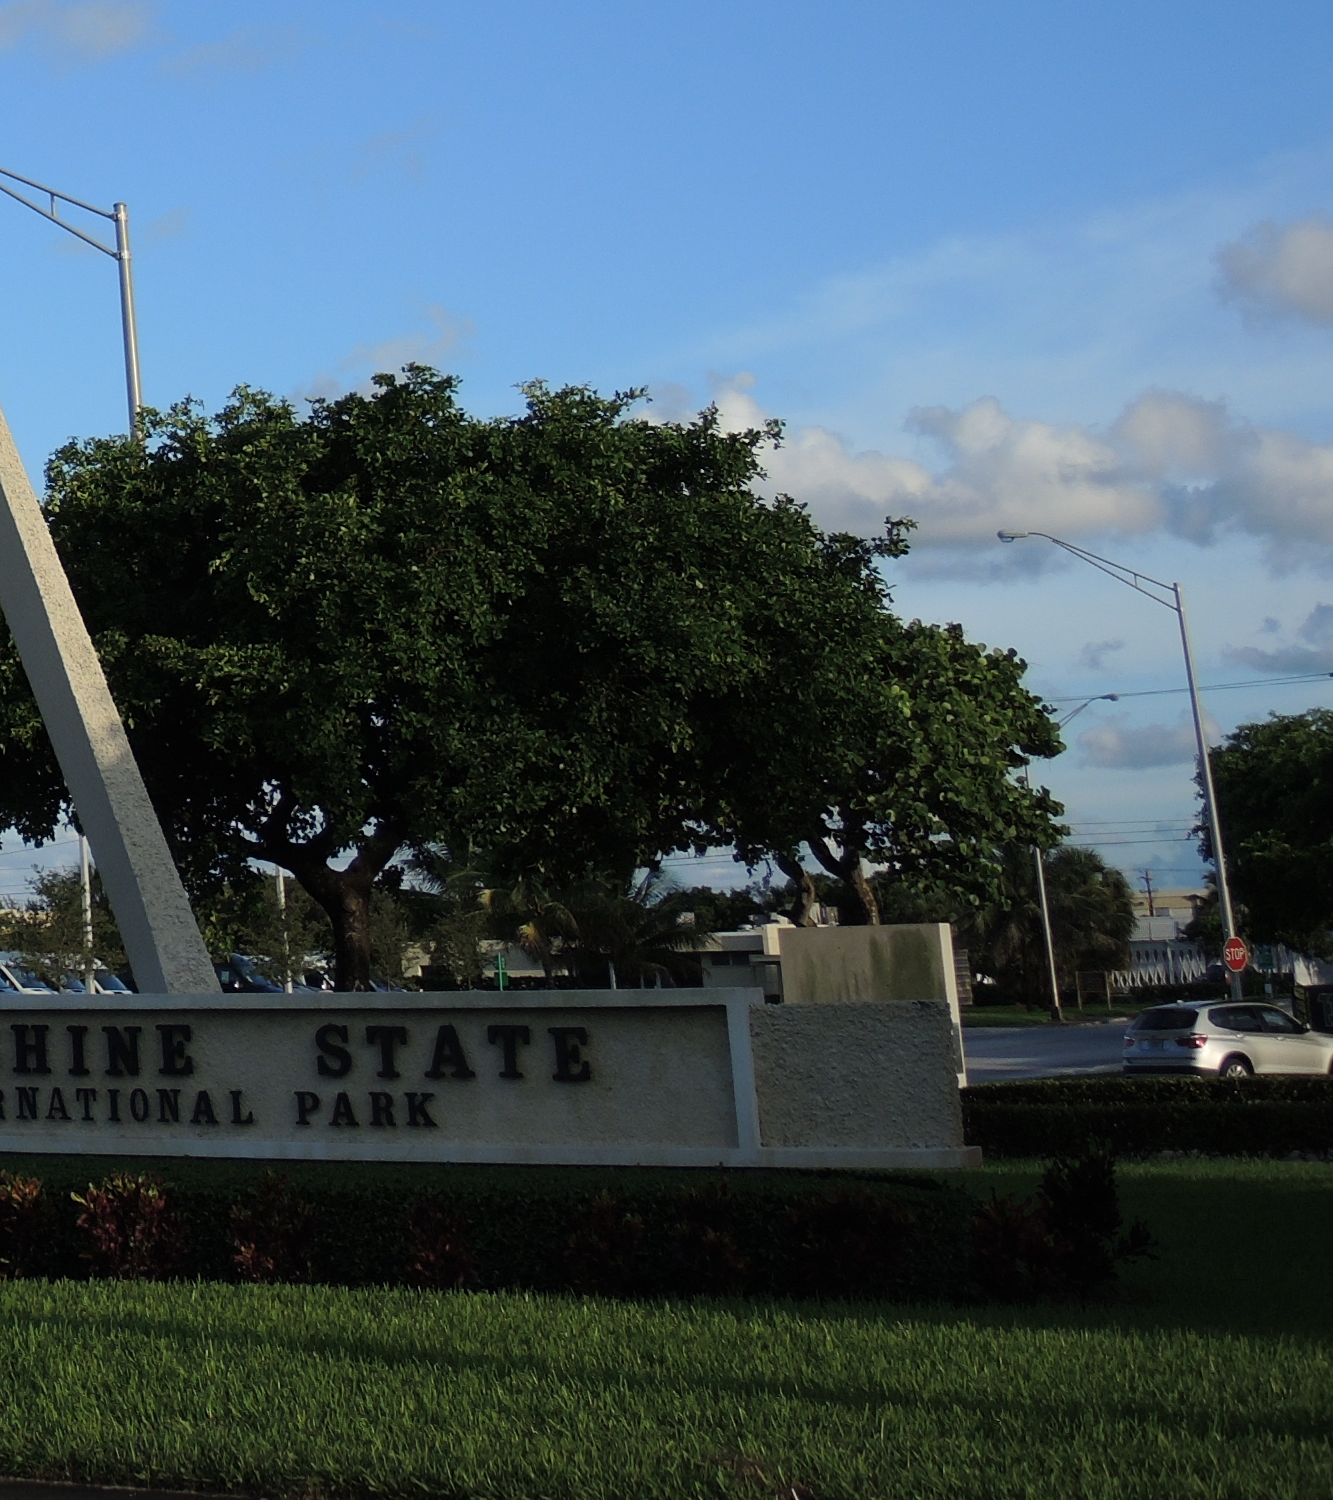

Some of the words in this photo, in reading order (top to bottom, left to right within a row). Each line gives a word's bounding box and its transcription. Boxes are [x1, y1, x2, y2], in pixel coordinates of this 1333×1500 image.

[1225, 947, 1246, 961] STOP
[314, 1022, 591, 1082] STATE
[294, 1090, 438, 1127] PARK
